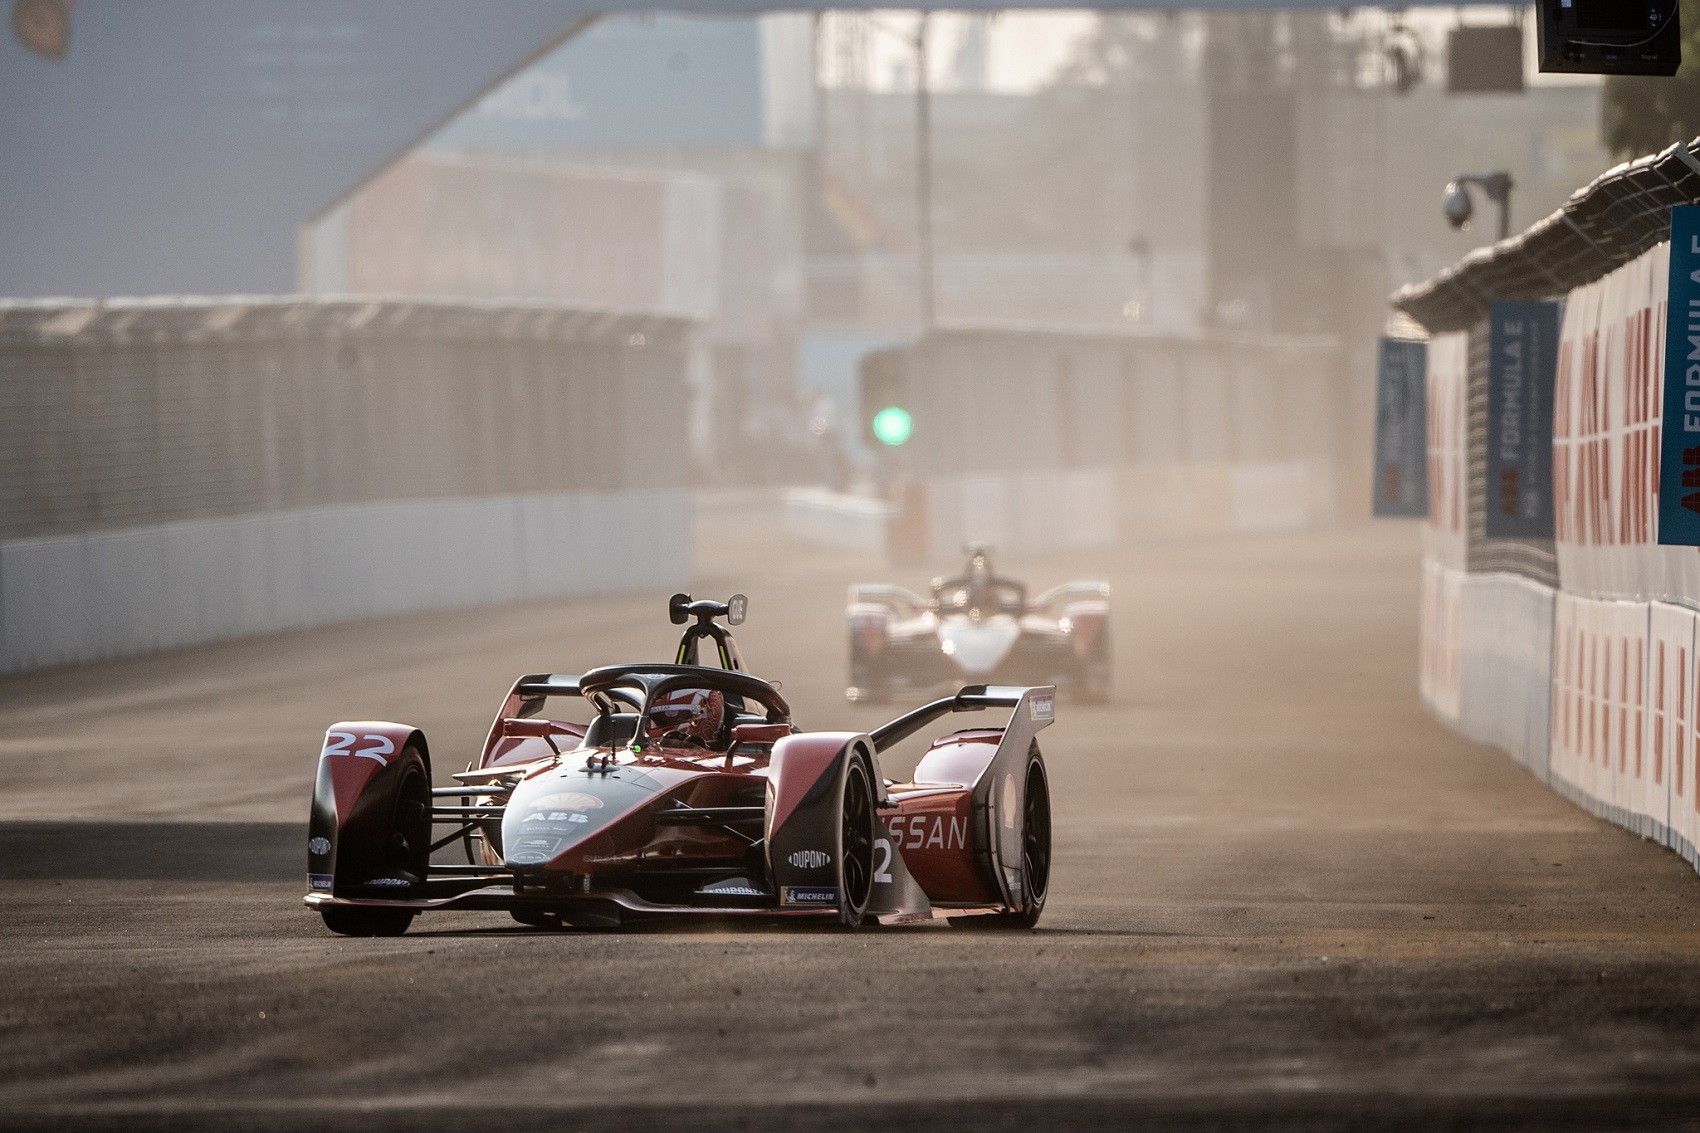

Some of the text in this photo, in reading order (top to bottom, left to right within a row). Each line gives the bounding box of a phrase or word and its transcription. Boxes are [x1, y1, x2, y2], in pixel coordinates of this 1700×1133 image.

[1500, 341, 1522, 461] FORMULA
[321, 732, 394, 767] 22
[521, 812, 588, 823] ABB
[881, 816, 967, 849] SSAN
[793, 850, 827, 868] DUPONT
